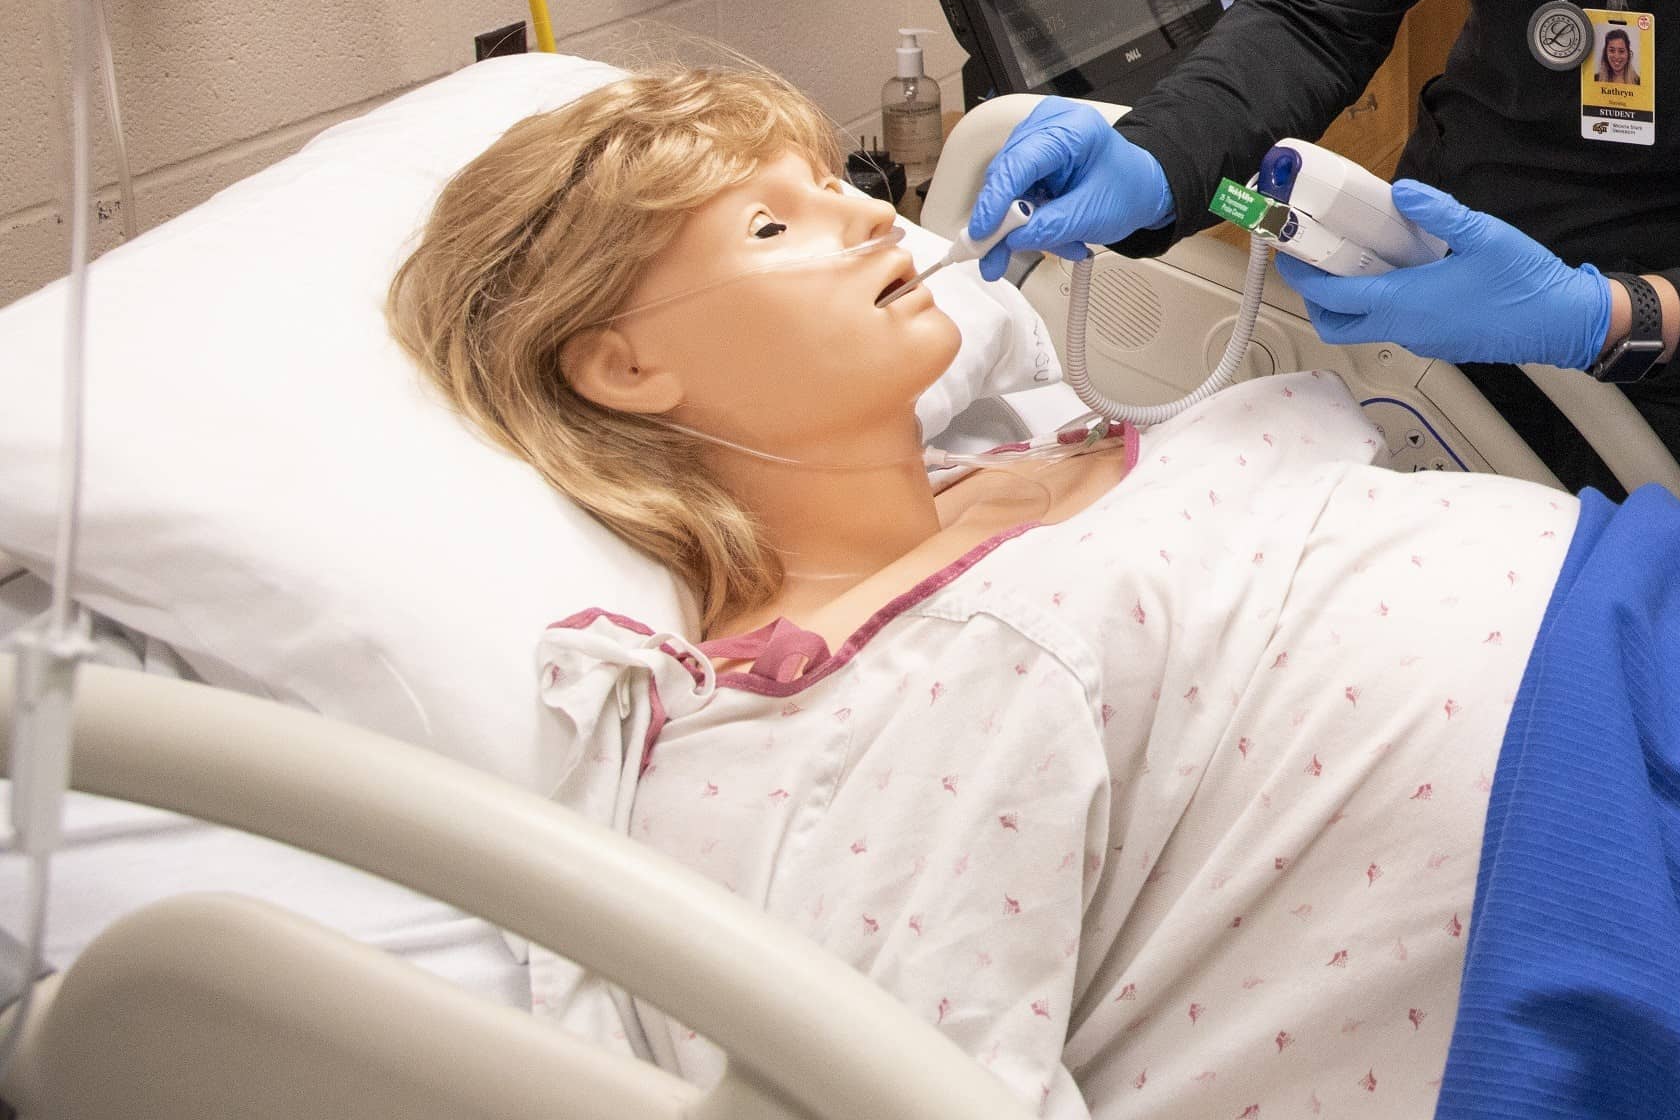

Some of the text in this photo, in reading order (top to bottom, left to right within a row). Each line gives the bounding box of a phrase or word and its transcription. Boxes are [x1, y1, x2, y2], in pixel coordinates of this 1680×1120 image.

[1124, 47, 1142, 63] DELL
[1600, 86, 1635, 98] Kathryn
[1599, 108, 1636, 119] STUDENT
